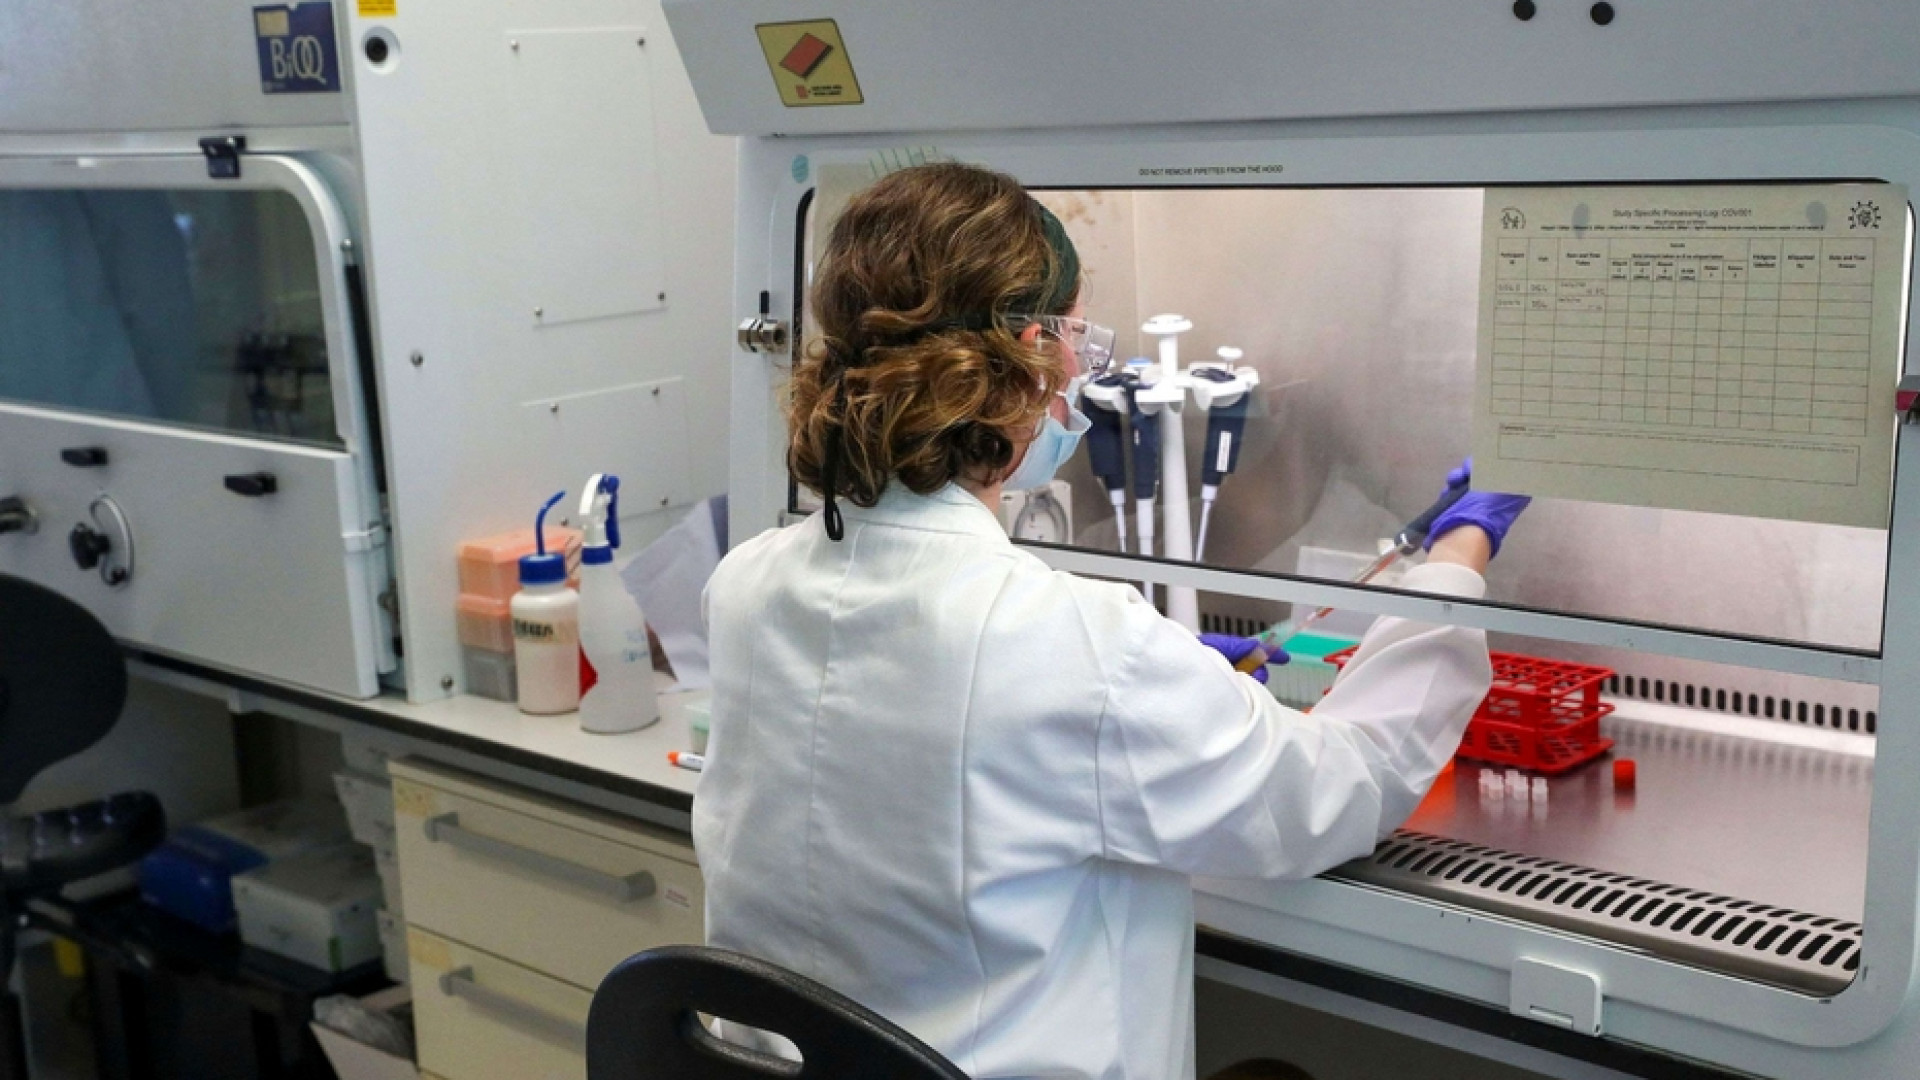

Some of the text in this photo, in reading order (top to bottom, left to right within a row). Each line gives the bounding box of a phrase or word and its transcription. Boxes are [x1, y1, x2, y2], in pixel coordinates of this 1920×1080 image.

[1139, 168, 1149, 176] DO
[1150, 168, 1163, 176] NOT
[1165, 168, 1192, 176] REMOVE
[1227, 166, 1246, 174] FROM
[1248, 165, 1260, 174] THE
[1612, 208, 1632, 218] Study
[1635, 208, 1661, 218] Specific
[1664, 208, 1702, 218] Processing
